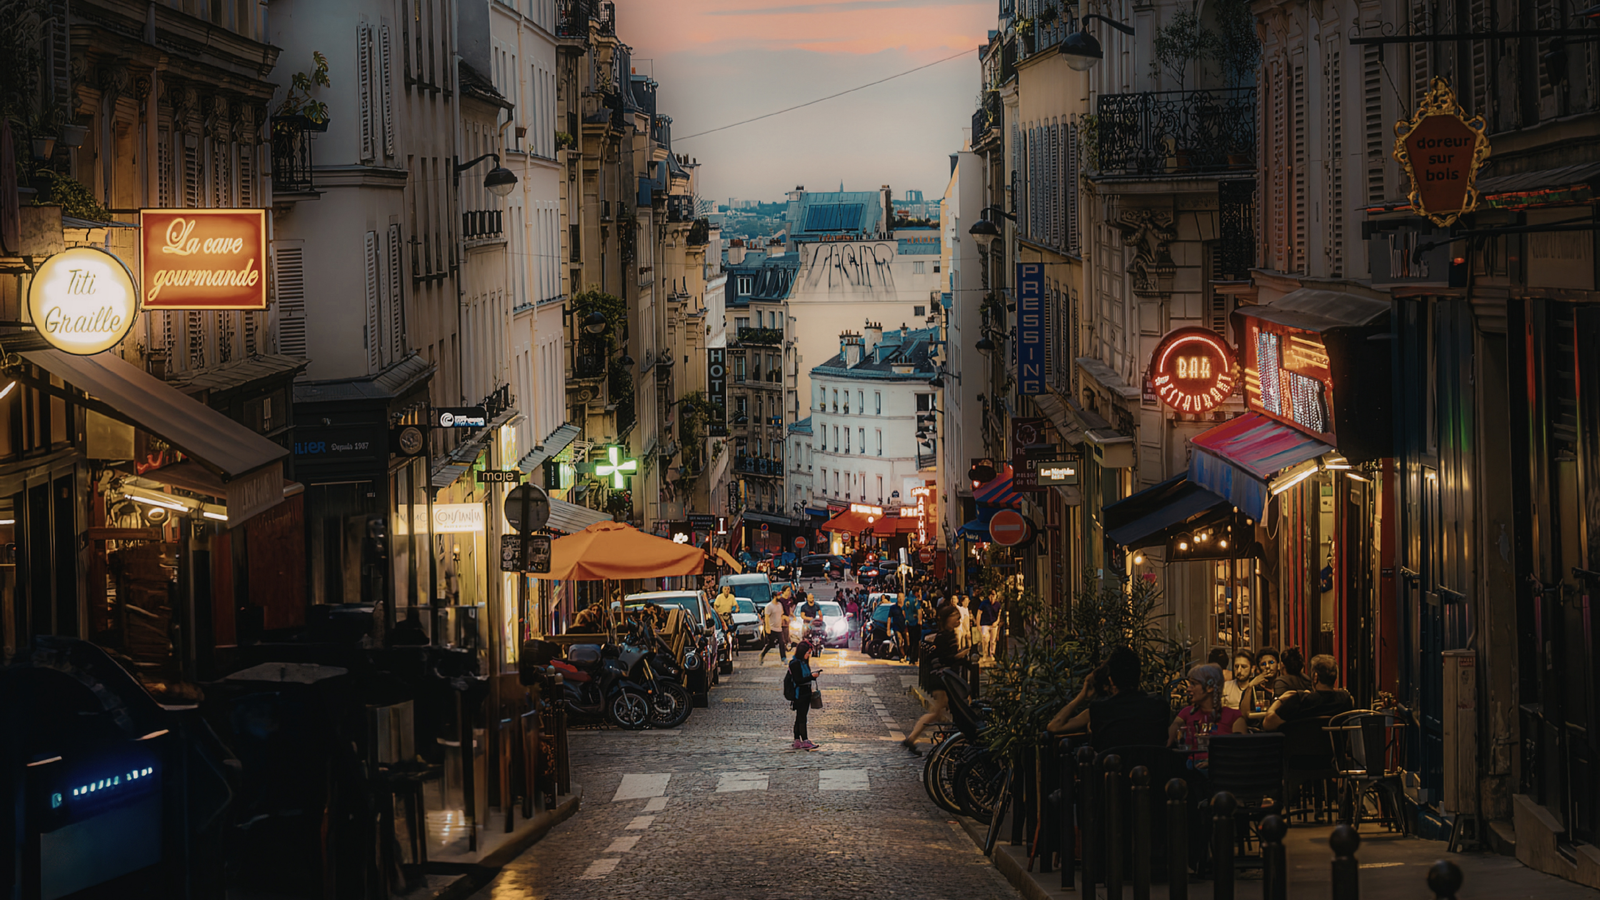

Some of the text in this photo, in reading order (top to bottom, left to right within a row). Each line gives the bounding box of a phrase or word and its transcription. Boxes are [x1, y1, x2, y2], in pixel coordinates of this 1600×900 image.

[1418, 138, 1471, 150] doreur
[1429, 154, 1455, 165] sur
[1427, 167, 1459, 181] bois
[162, 218, 243, 256] La cave
[66, 269, 96, 296] Titi
[147, 258, 259, 302] gourmande
[44, 305, 123, 334] Graille
[1023, 264, 1040, 394] PRESSING
[1178, 356, 1210, 379] BAR
[1155, 373, 1232, 412] RESTAURANT
[482, 470, 514, 482] maje
